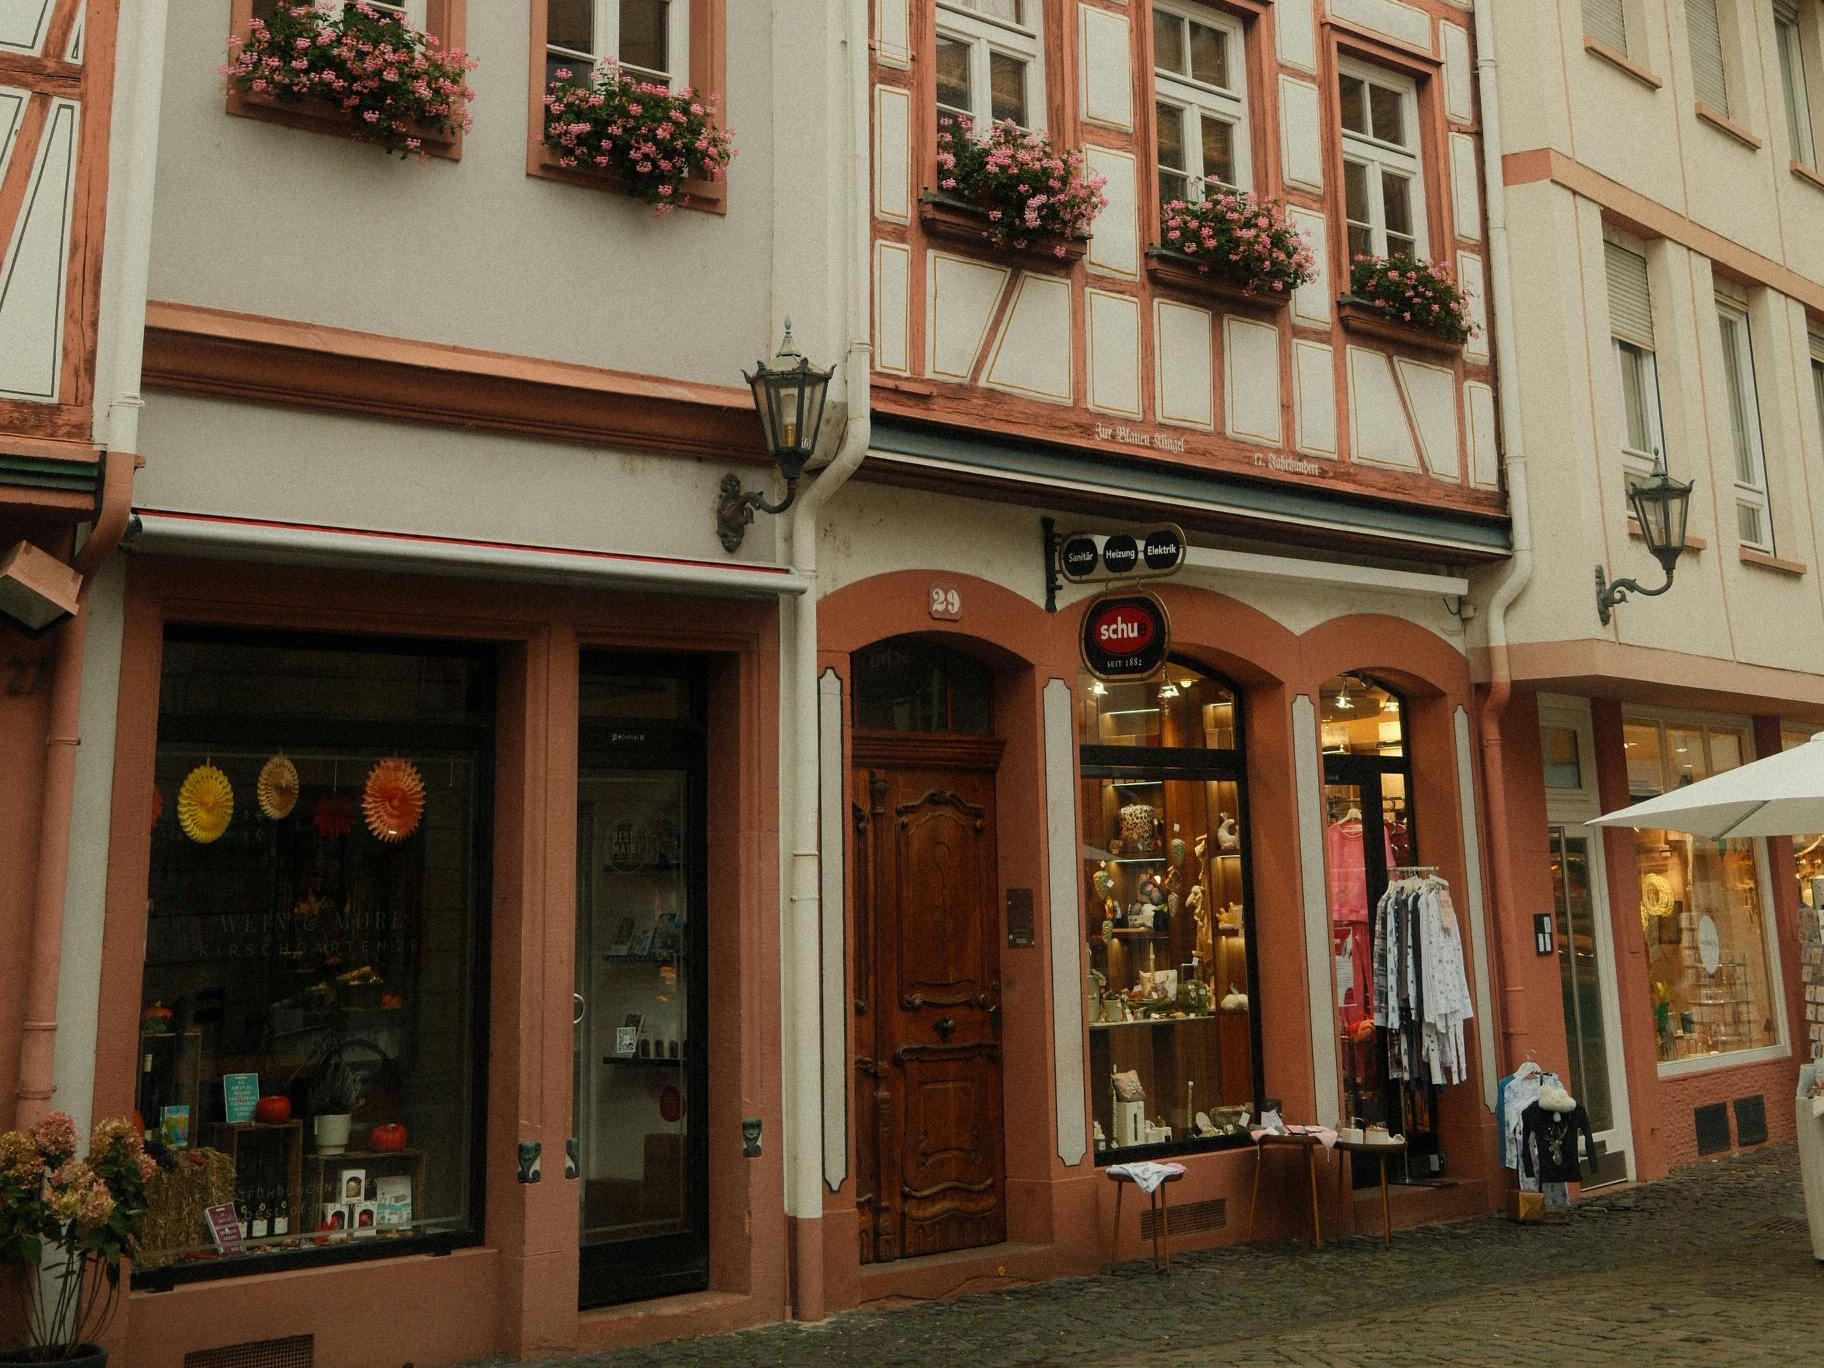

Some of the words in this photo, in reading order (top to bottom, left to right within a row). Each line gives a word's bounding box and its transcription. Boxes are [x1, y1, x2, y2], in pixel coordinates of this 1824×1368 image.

[1095, 422, 1113, 441] Zur
[1116, 425, 1150, 447] Blauen
[1105, 549, 1136, 560] Heizung
[1147, 543, 1177, 556] Elektrik
[1068, 551, 1094, 563] Sanitär
[932, 588, 960, 614] 29
[1107, 659, 1123, 668] SEIT
[1125, 657, 1143, 667] 1882
[220, 913, 291, 933] WEIN
[333, 910, 407, 931] MORE
